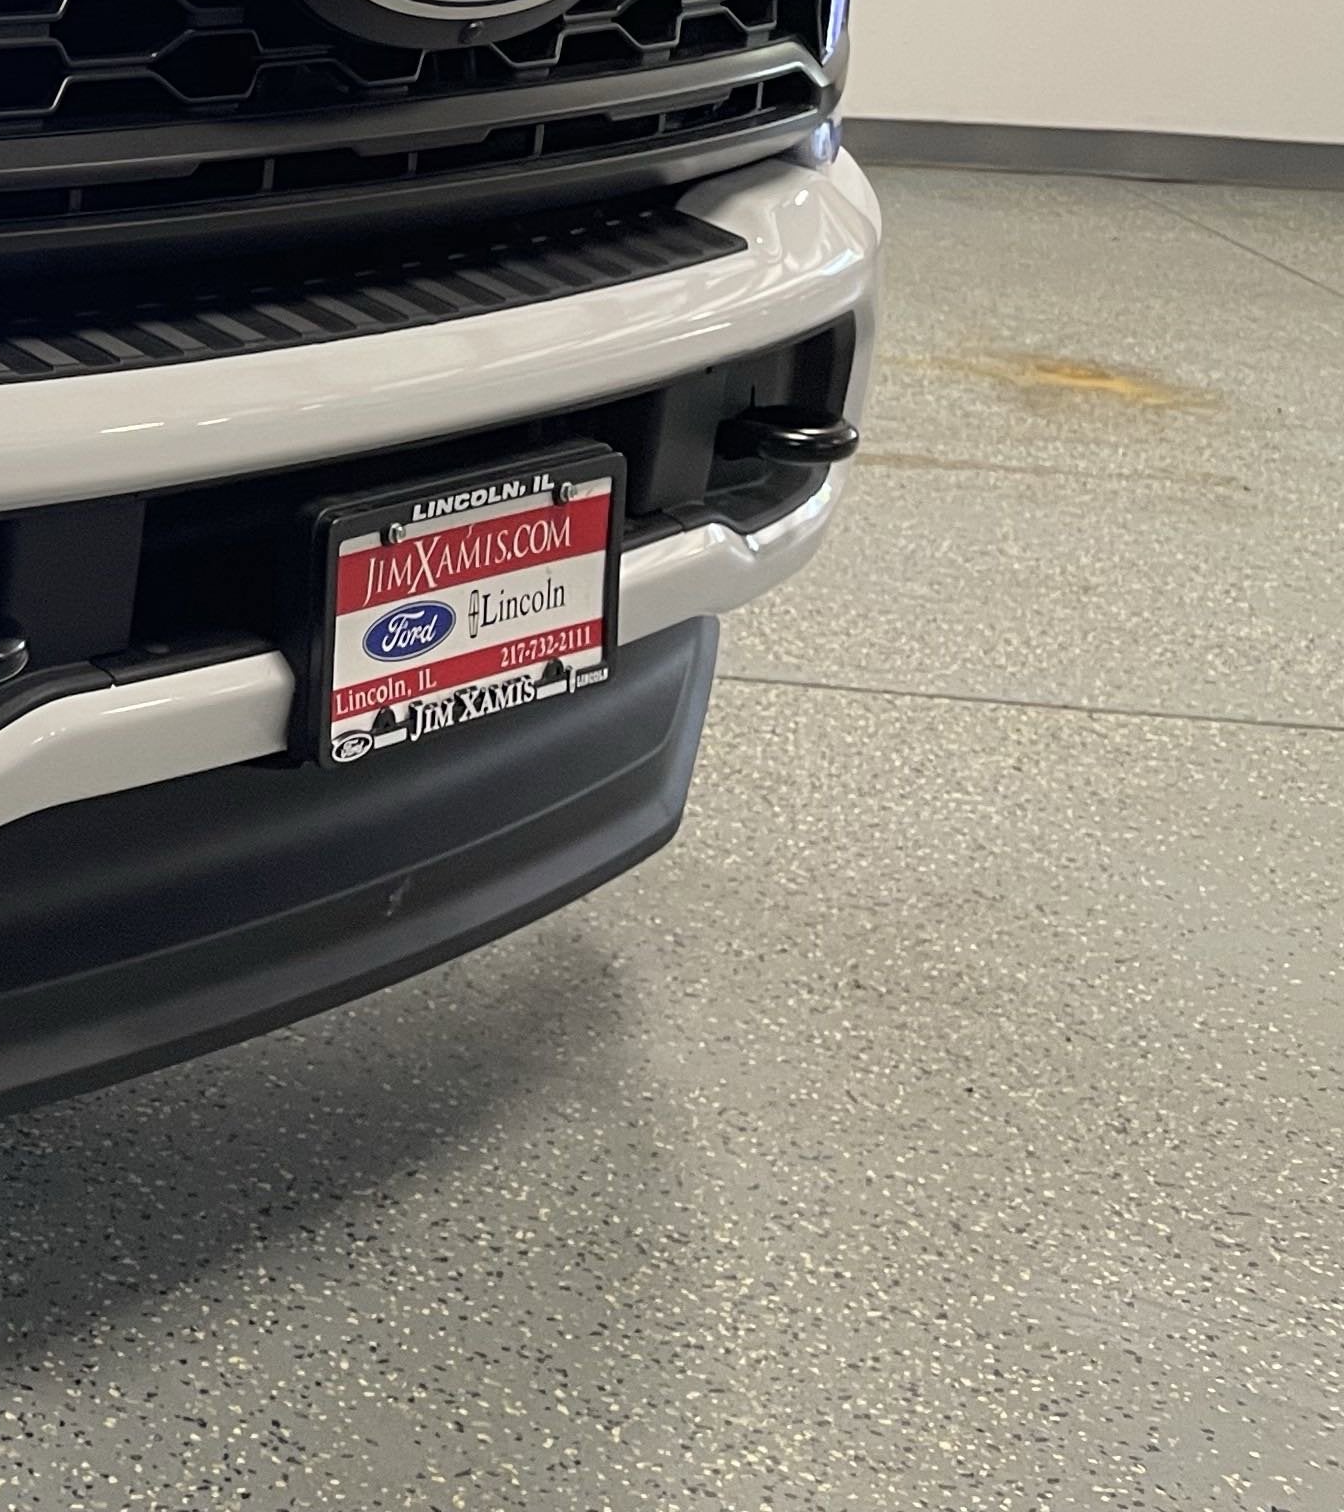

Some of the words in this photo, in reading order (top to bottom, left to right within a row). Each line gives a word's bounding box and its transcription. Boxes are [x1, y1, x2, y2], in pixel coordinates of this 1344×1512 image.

[412, 480, 526, 522] LINCOLN,
[532, 473, 555, 494] IL
[480, 578, 566, 628] Lincoln
[381, 610, 438, 653] Ford
[499, 626, 592, 669] 217-732-2111
[335, 676, 412, 715] Lincoln,
[417, 668, 438, 690] IL
[409, 701, 456, 742] JIM
[459, 678, 536, 723] XAMIS
